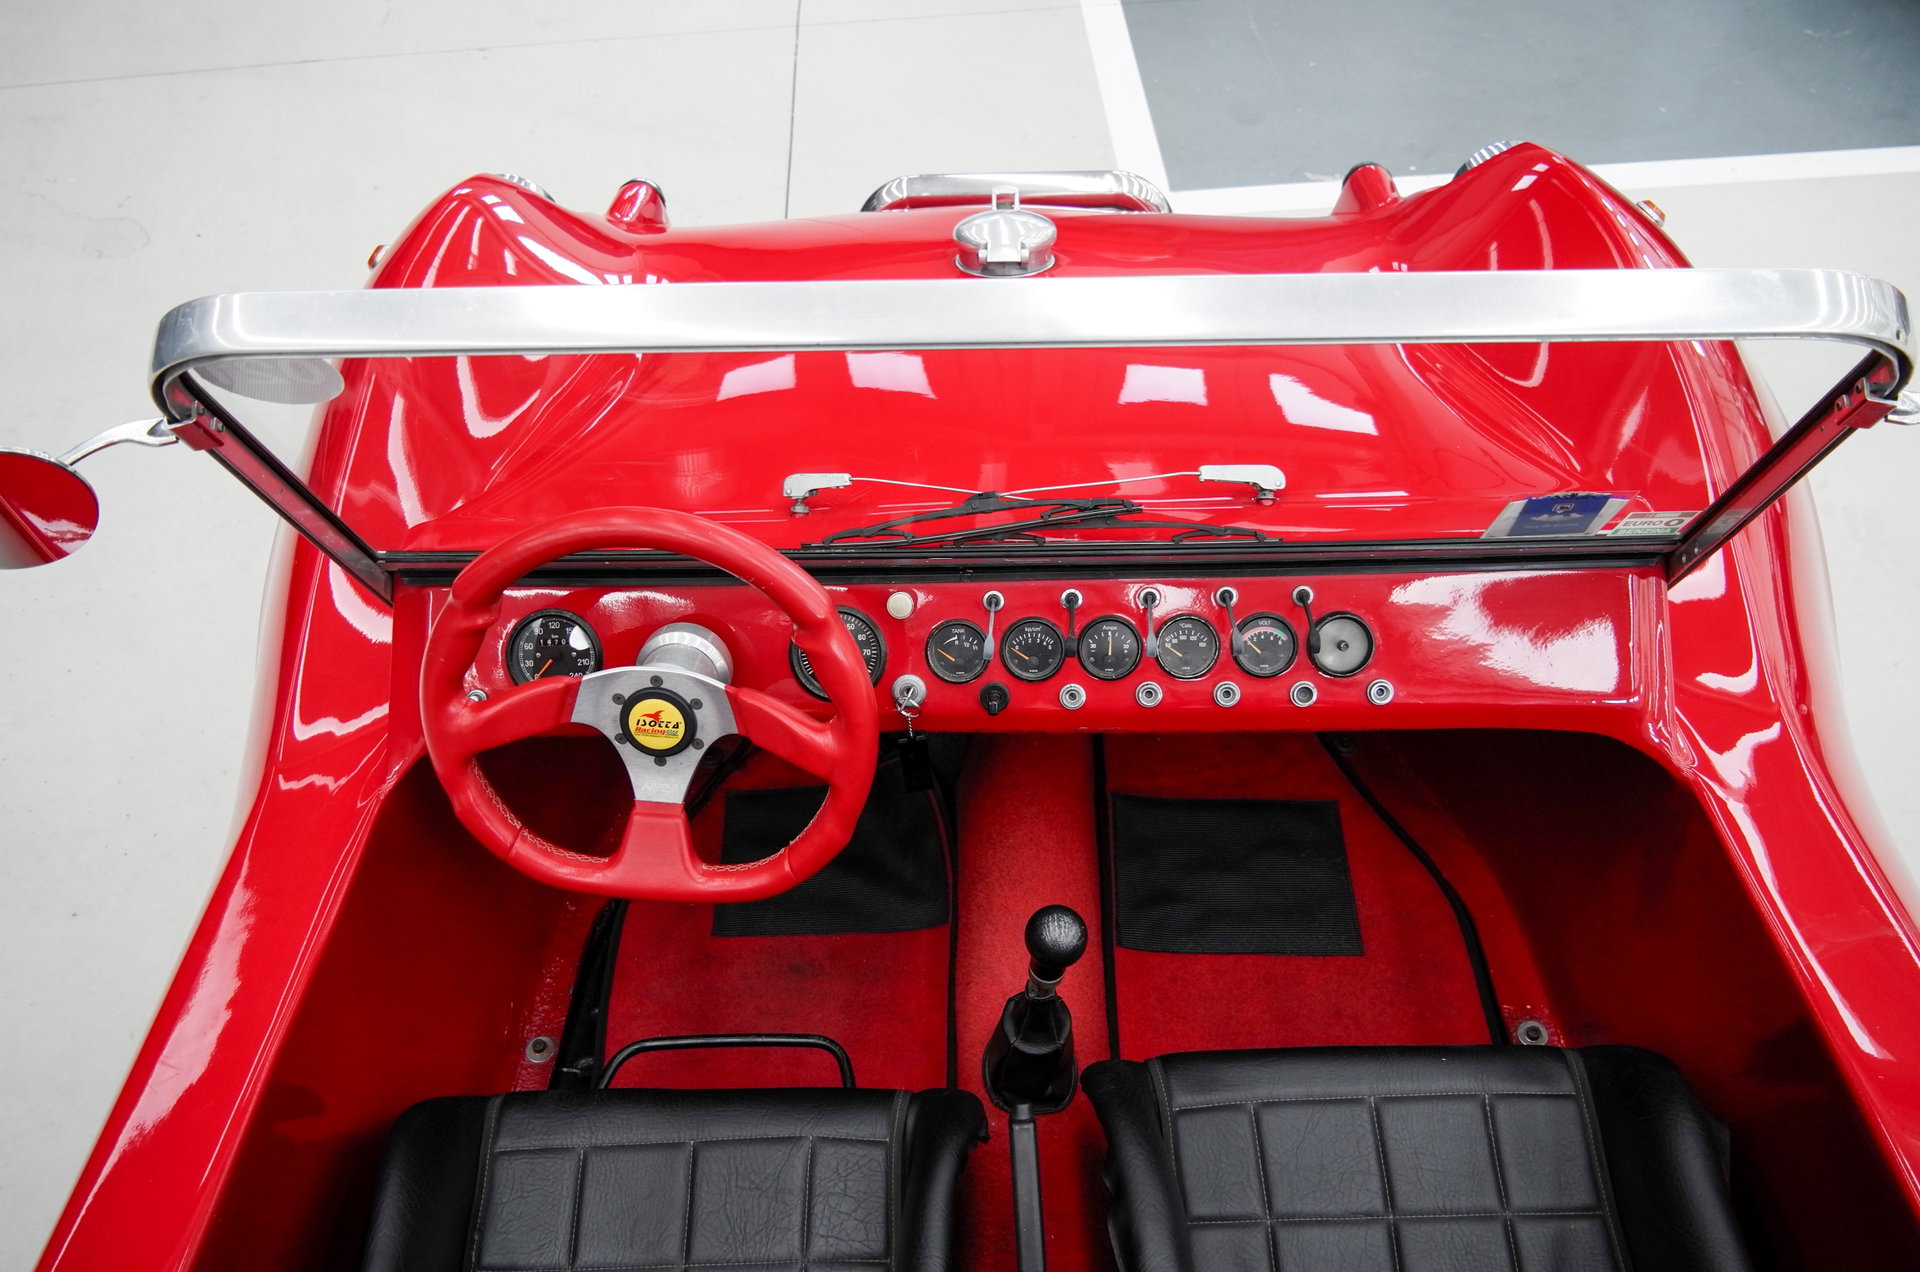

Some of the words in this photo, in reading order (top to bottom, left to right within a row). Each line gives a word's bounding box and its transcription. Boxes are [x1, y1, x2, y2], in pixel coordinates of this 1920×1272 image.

[1618, 527, 1671, 535] BENZINA
[548, 621, 560, 629] 120
[533, 627, 543, 635] 90
[857, 633, 867, 641] 60
[523, 642, 534, 650] 60
[524, 659, 534, 667] 30
[577, 658, 590, 666] 210
[635, 718, 680, 729] ISOTTA
[634, 726, 667, 736] Racing
